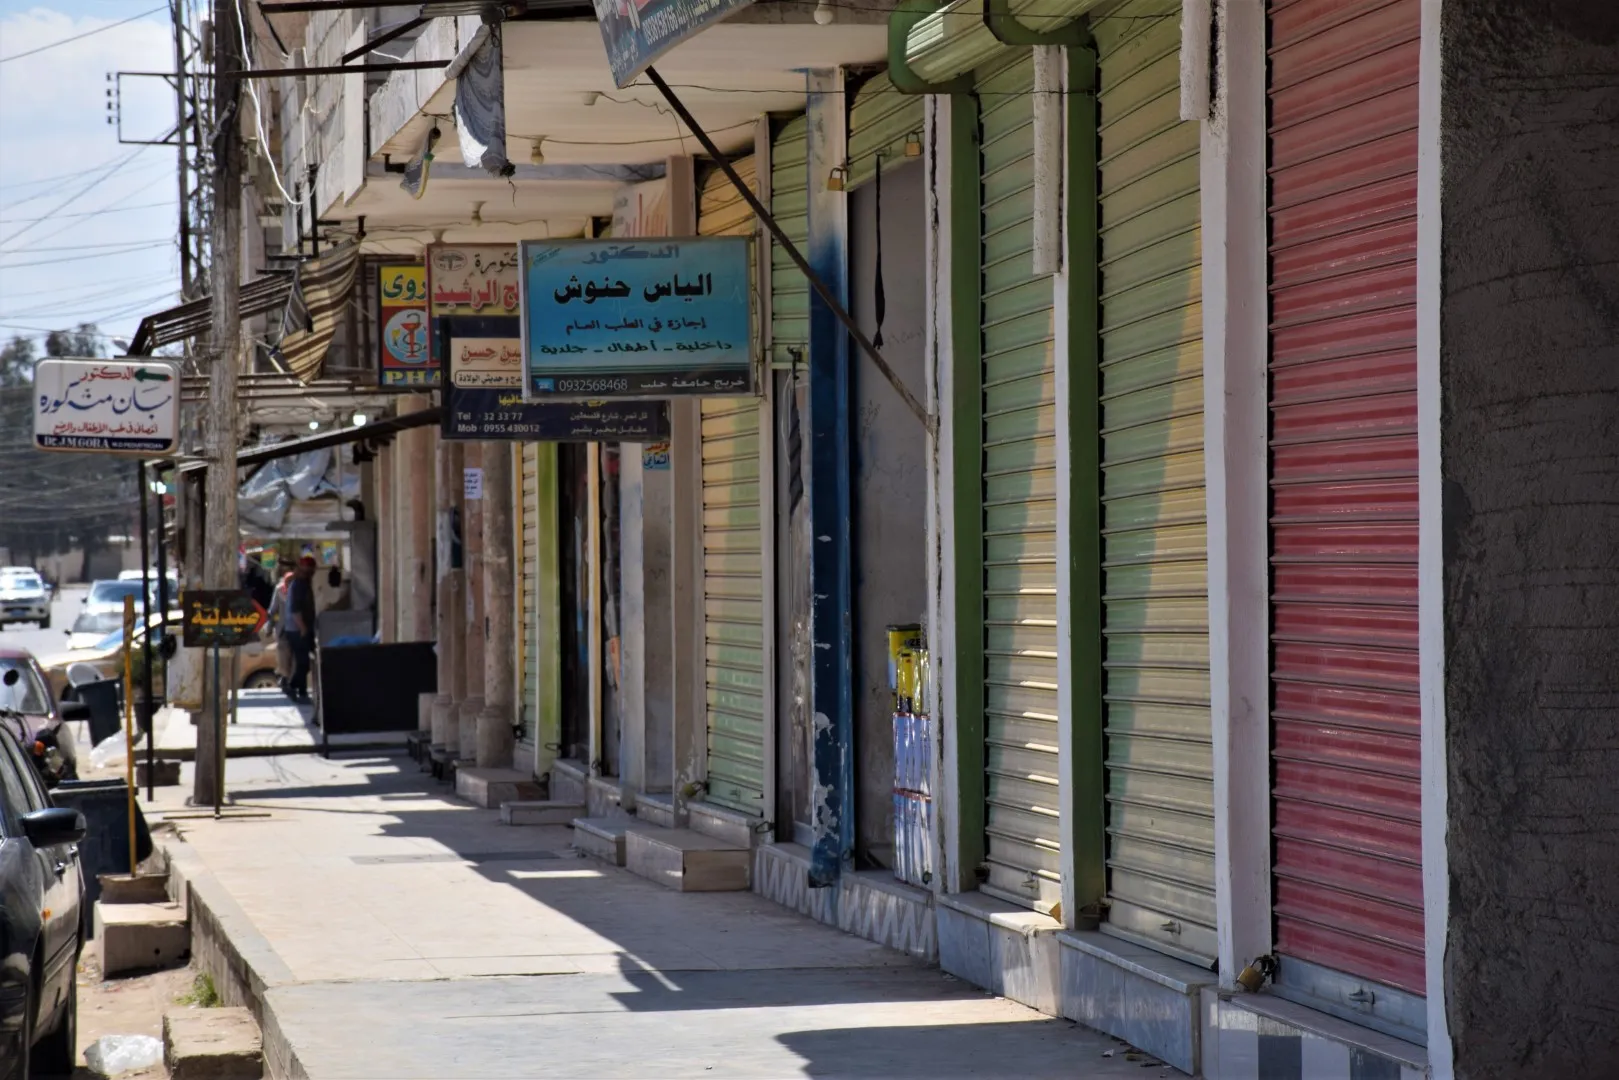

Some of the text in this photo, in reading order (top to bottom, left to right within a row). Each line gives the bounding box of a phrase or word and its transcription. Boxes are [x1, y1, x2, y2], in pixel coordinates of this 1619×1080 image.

[582, 244, 680, 264] الدكتور
[434, 279, 497, 308] الرشيد
[554, 272, 712, 304] الياس حنوش
[566, 317, 706, 335] إجازة في الطب العام
[461, 345, 496, 362] حسن
[541, 340, 732, 354] داخلية أطفال جلدية
[80, 366, 134, 382] الدكتور
[459, 374, 480, 383] الولادة
[559, 379, 628, 392] 0932568468
[640, 378, 745, 390] خريج جامعة حلب
[457, 412, 523, 421] Tel 32 33 77
[570, 411, 600, 422] فلسطين
[601, 411, 619, 423] شارع
[458, 424, 477, 432] Mob
[484, 424, 505, 432] 0955
[191, 601, 260, 633] صيدلية
